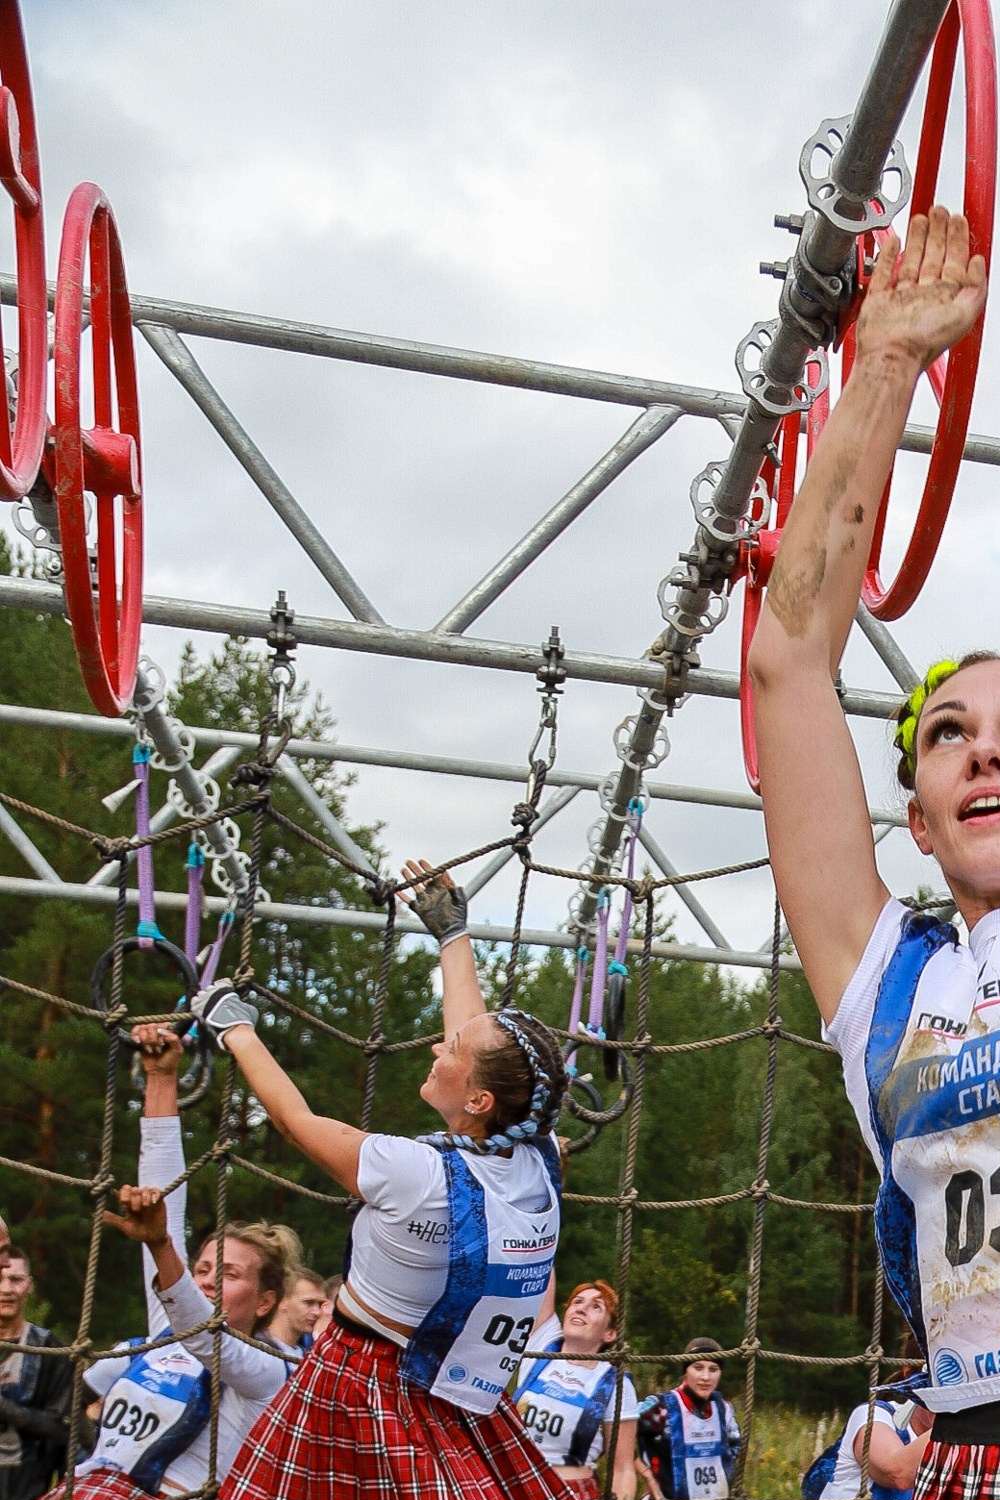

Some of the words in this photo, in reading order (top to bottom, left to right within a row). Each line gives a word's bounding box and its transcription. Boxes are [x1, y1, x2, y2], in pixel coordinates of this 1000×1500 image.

[917, 1012, 967, 1035] ГОН
[503, 1238, 537, 1249] ГОНКА
[521, 1278, 546, 1293] СТАРТ
[102, 1398, 160, 1442] 030
[524, 1404, 564, 1437] 030
